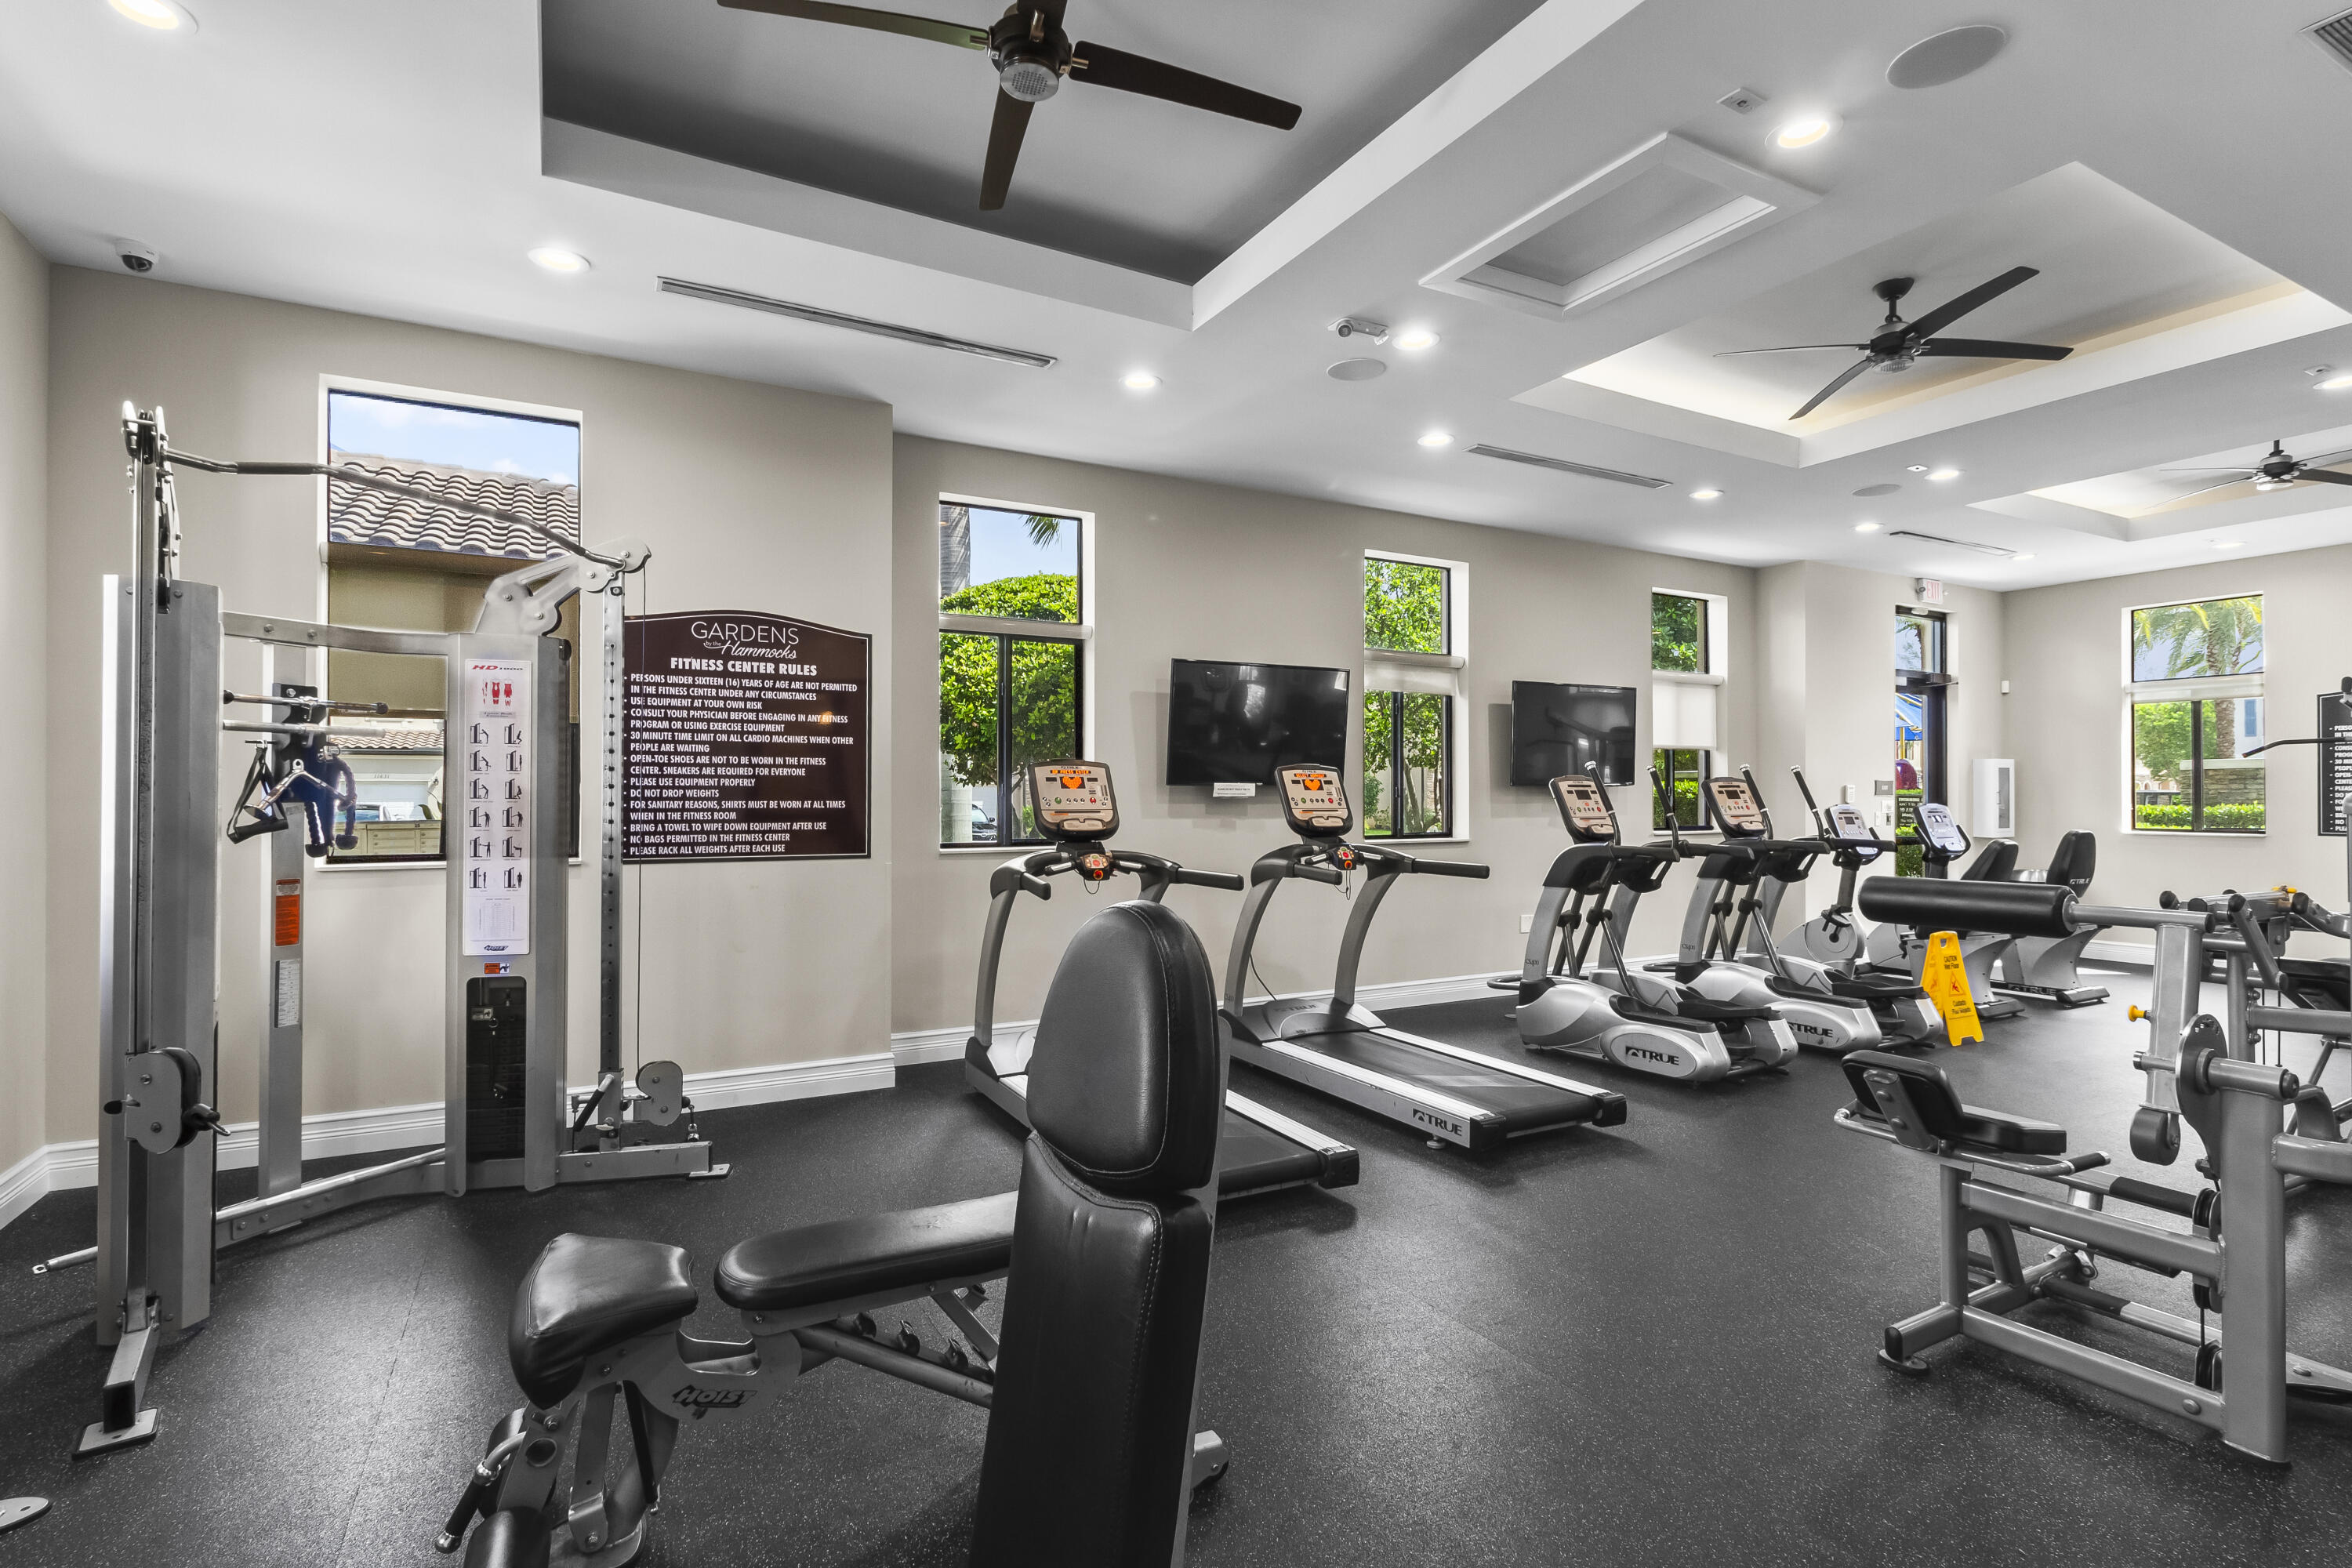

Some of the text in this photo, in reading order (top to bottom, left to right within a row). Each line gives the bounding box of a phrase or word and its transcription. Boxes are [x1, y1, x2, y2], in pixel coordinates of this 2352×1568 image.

[1926, 581, 1940, 601] EXIT
[691, 622, 799, 644] GARDENS
[721, 640, 797, 659] Hammocks
[670, 658, 818, 676] FITNESS CENTER RULES
[630, 673, 858, 691] PERSONS UNDER SIXTEEN (16) YEARS OF AGE ARE NOT PERMITTED
[630, 685, 817, 701] IN THE FITNESS CENTER UNDER ANY CIRCUMSTANCES
[630, 697, 644, 706] USE
[648, 698, 691, 707] EQUIPMENT
[705, 699, 724, 708] YOUR
[727, 700, 744, 709] OWN
[747, 701, 763, 710] RISK
[630, 709, 665, 717] CONSULT
[667, 710, 688, 718] YOUR
[690, 710, 728, 720] PHYSICIAN
[731, 712, 756, 720] BEFORE
[759, 713, 796, 721] ENGAGING
[630, 720, 669, 729] PROGRAM
[744, 724, 785, 732] EQUIPMENT
[630, 731, 640, 740] 30
[643, 732, 672, 741] MINUTE
[695, 733, 714, 742] LIMIT
[630, 743, 659, 752] PEOPLE
[630, 755, 668, 764] OPEN-TOE
[659, 778, 673, 786] USE
[665, 823, 689, 832] TOWEL
[695, 845, 728, 854] WEIGHTS
[2019, 985, 2057, 996] TRUE
[1792, 1022, 1833, 1038] TRUE
[1639, 1048, 1679, 1066] TRUE
[1425, 1112, 1462, 1137] TRUE
[673, 1387, 758, 1405] HOIST
